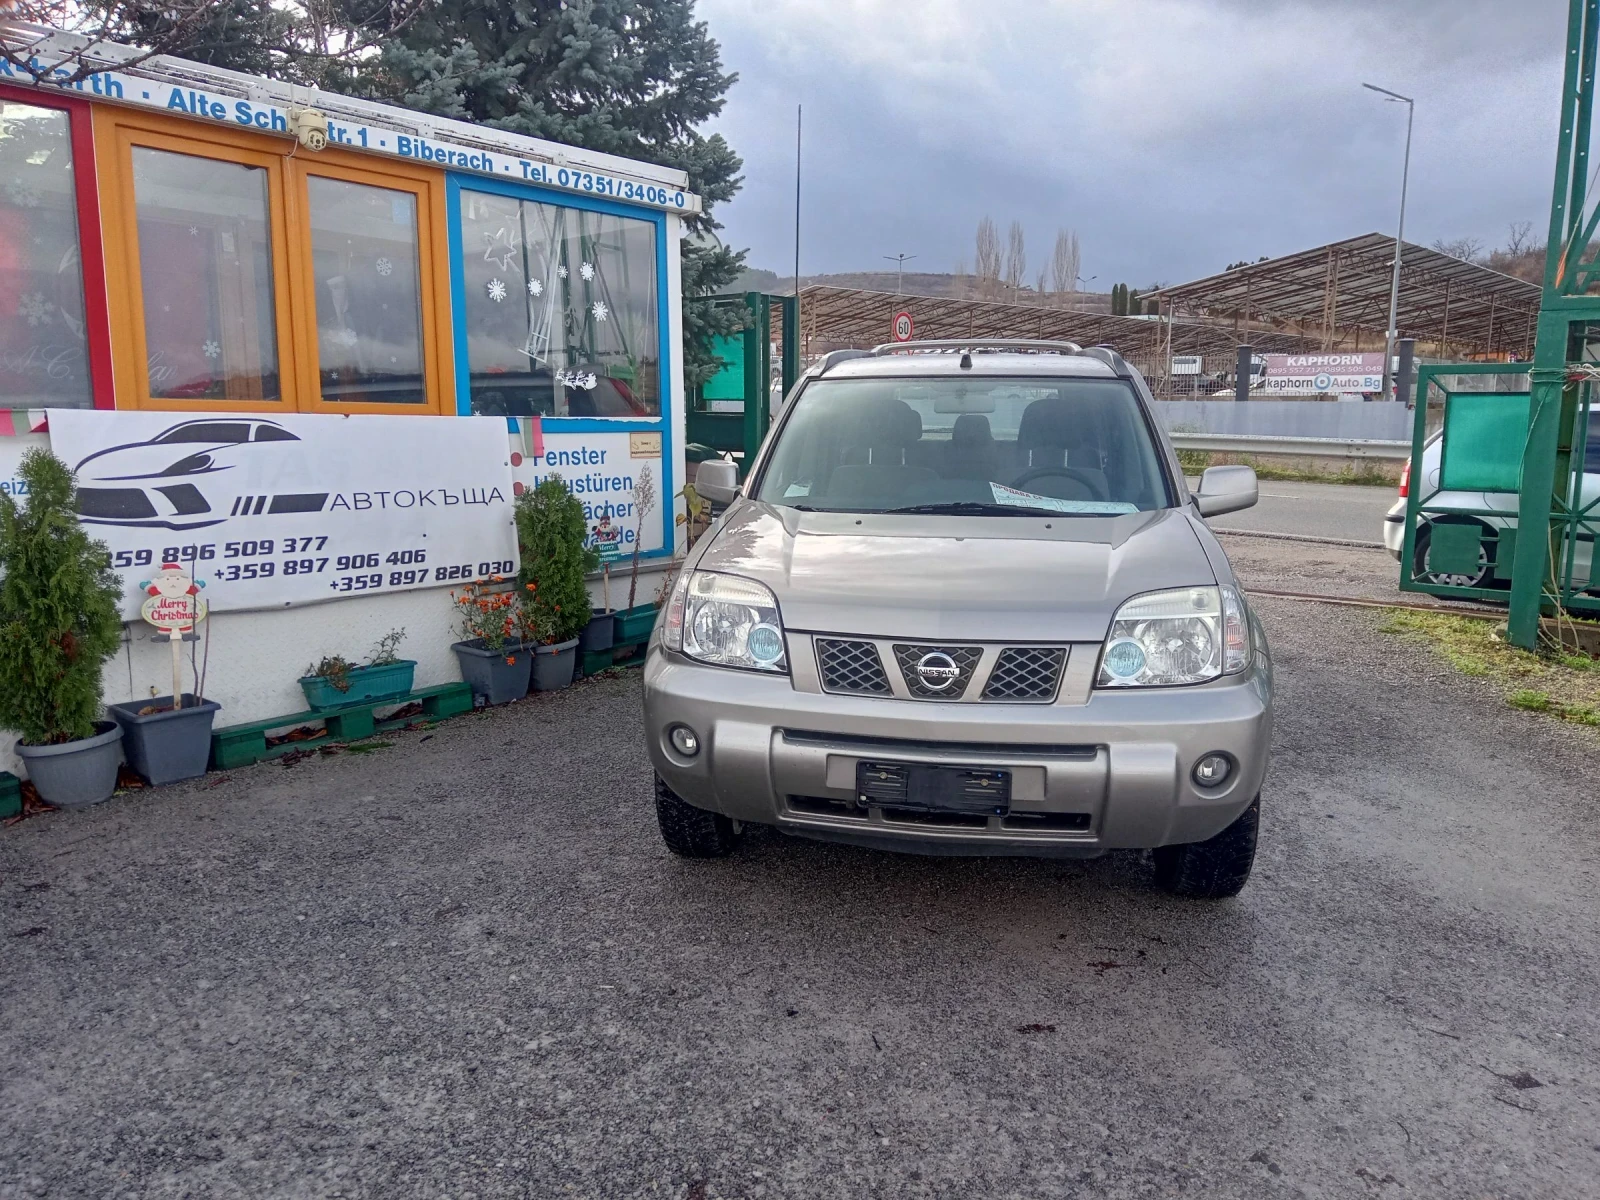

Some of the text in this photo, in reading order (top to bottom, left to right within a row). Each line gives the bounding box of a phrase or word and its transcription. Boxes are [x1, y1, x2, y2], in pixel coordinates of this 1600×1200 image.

[167, 88, 227, 120] Alte
[397, 136, 494, 172] Biberach
[519, 160, 553, 184] Tel.
[557, 168, 685, 208] 07351/3406-0
[898, 321, 909, 335] 60
[1287, 355, 1362, 366] KAPHORN
[1348, 365, 1364, 373] 505
[1266, 377, 1380, 391] kaphorn Auto.Bg
[534, 472, 633, 494] Hustüren
[330, 487, 505, 512] АВТОКЪЩА
[583, 500, 634, 520] ächer
[108, 536, 328, 568] 59 896 509 377
[214, 549, 427, 581] +359 897 906 406
[330, 560, 514, 592] +359 897 826 030
[157, 598, 188, 612] Merry
[151, 609, 199, 621] Christmas
[918, 668, 955, 677] NISSAN
